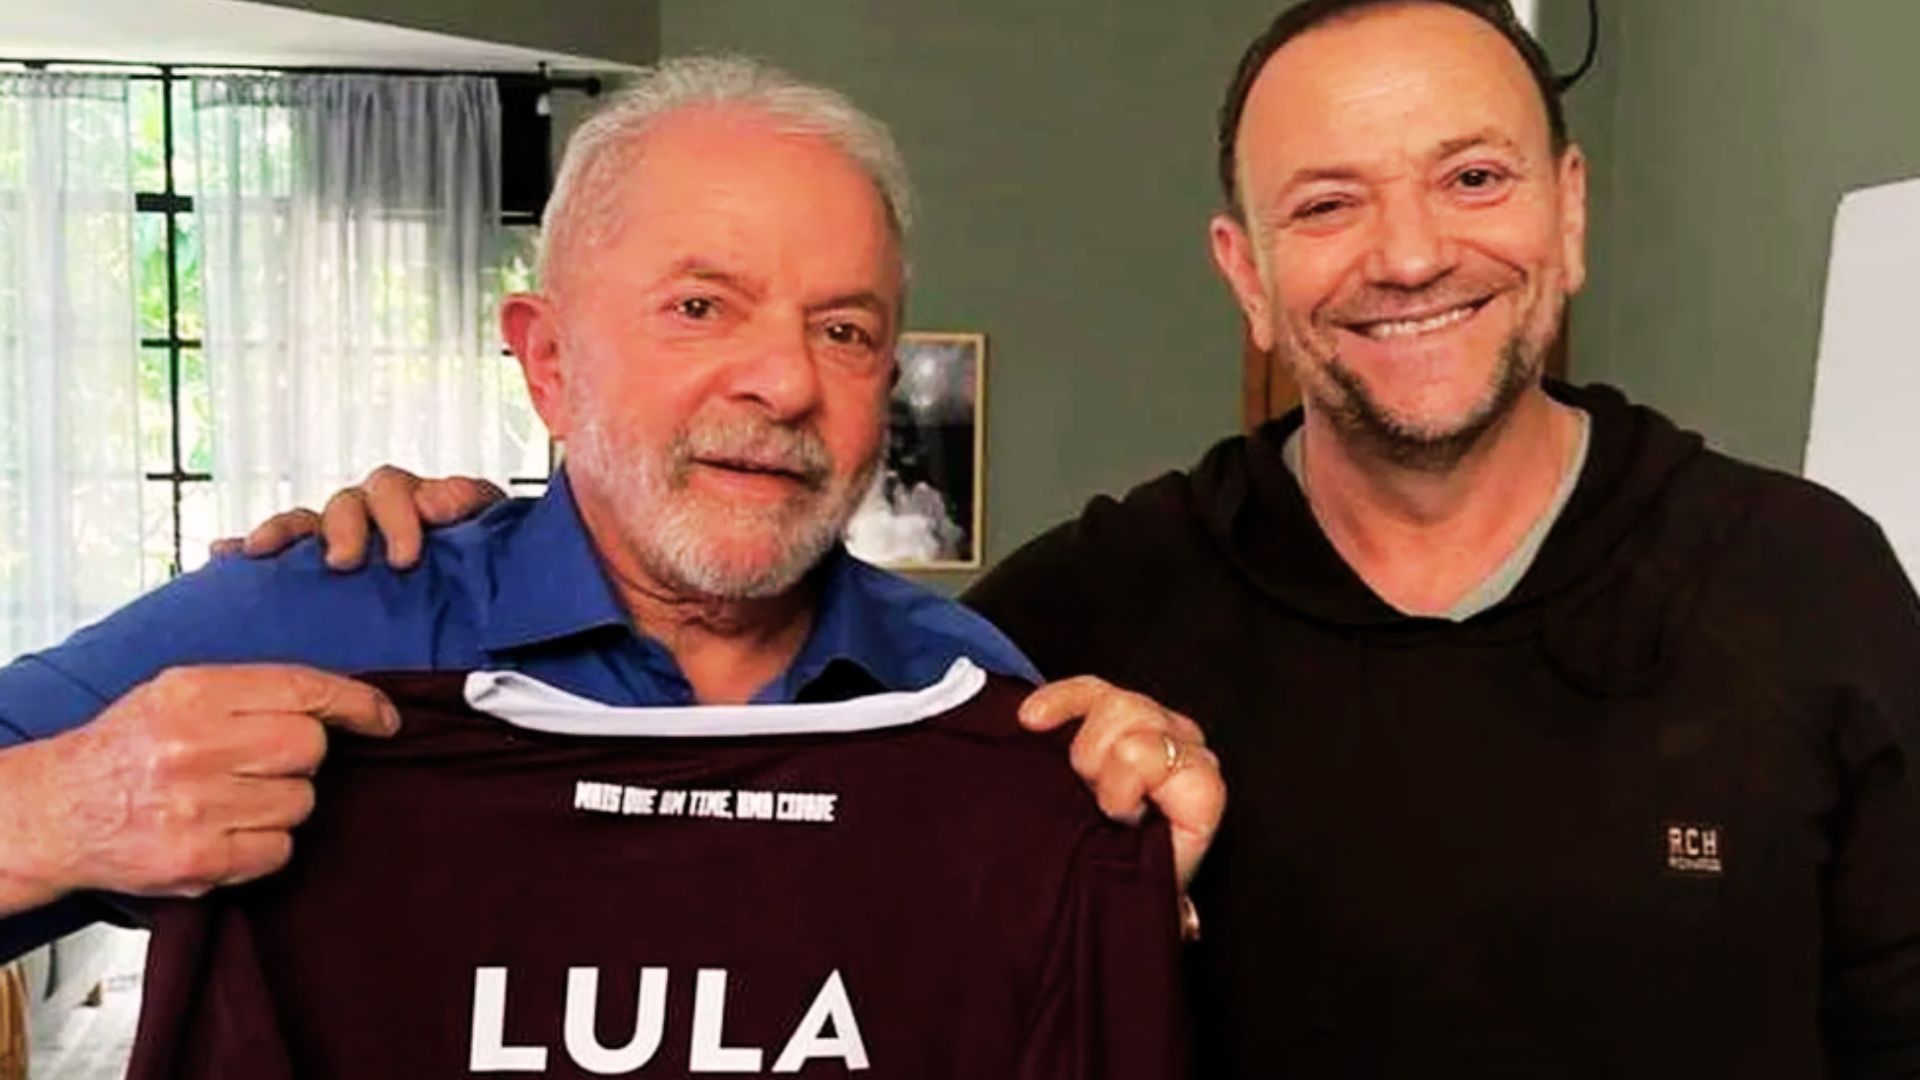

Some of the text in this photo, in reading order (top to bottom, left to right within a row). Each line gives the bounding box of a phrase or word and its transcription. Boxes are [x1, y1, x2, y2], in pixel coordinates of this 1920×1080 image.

[575, 781, 622, 812] MAIS
[1668, 827, 1718, 856] RCH
[470, 966, 869, 1074] LULA
